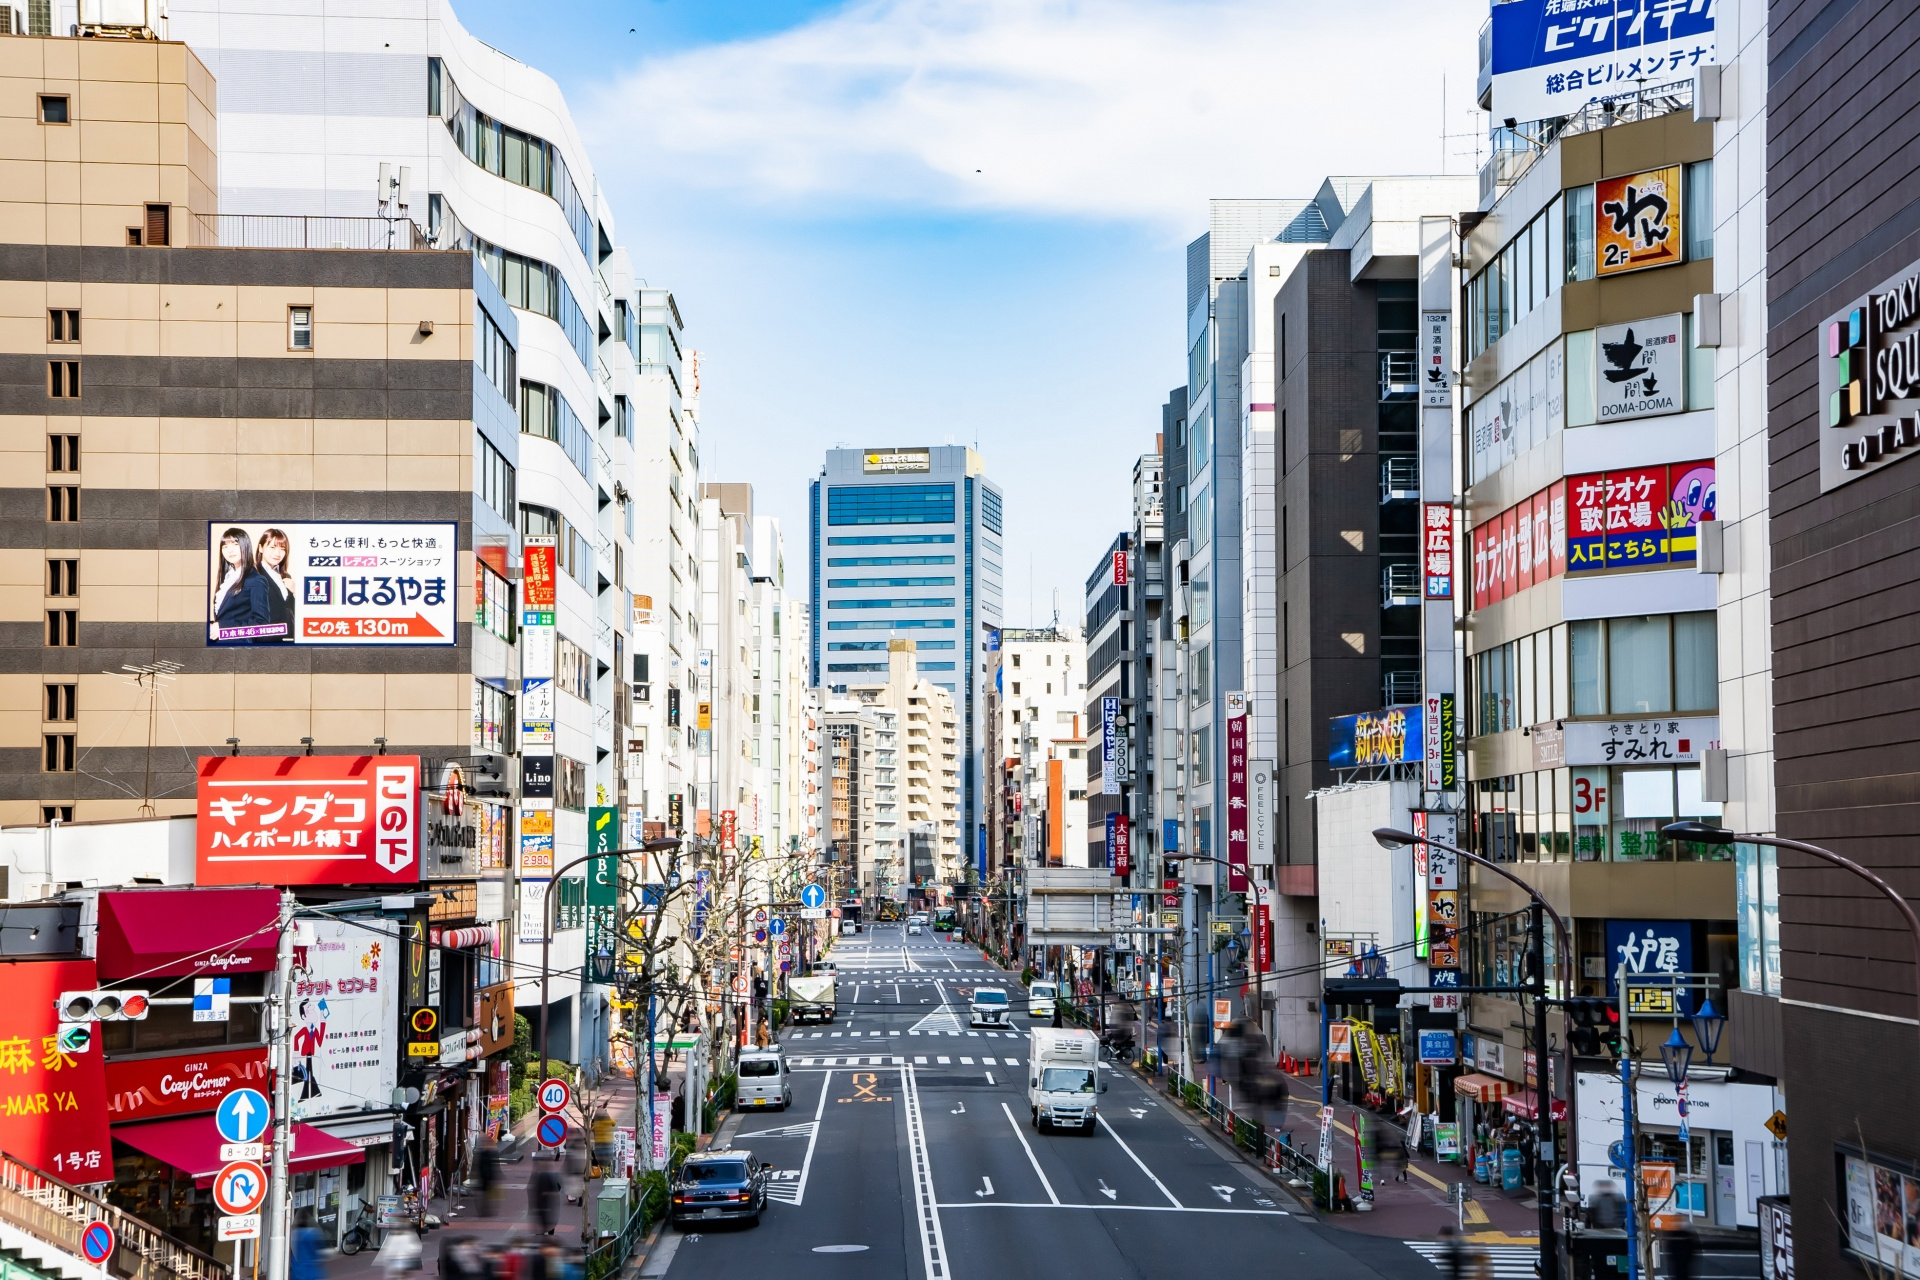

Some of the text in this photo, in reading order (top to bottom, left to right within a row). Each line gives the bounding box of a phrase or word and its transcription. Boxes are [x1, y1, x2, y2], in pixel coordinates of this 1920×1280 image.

[1602, 186, 1669, 248] わん
[1604, 244, 1629, 267] 2F
[1645, 335, 1669, 347] 居酒家
[1602, 397, 1673, 416] DOMA-DOMA
[1576, 475, 1656, 507] カラオケ
[1580, 501, 1652, 532] 歌広場
[309, 537, 443, 549] もっと便利、もっと快適。
[1427, 506, 1450, 575] 歌広場
[1475, 495, 1565, 594] カラオケ歌広場
[1570, 538, 1656, 563] 入口こちら
[312, 556, 442, 566] メンズ レディス スーツショップ
[341, 576, 446, 606] はるやま
[1429, 578, 1449, 594] 5F
[307, 620, 409, 635] この先 130m
[1105, 710, 1117, 761] はるやま
[1355, 710, 1407, 764] 新台入替
[1428, 715, 1440, 760] 当ビル 3F
[1608, 722, 1680, 736] やきとり家
[1231, 720, 1244, 784] 韓国料理
[1442, 699, 1454, 786] シティクリニック
[1601, 737, 1673, 761] すみれ
[1117, 738, 1126, 776] 2900
[525, 773, 551, 782] Lino
[1574, 777, 1606, 813] 3F
[209, 790, 366, 826] ギンダコ
[381, 775, 407, 865] この下
[1257, 787, 1265, 850] FEELCYCLE
[211, 828, 362, 849] ハイボール横丁
[1116, 823, 1128, 867] 大阪王将
[1447, 817, 1456, 866] やきと家
[595, 833, 608, 885] SMBC
[1430, 834, 1447, 875] すみれ
[1431, 898, 1456, 919] わん
[210, 953, 230, 970] Cozy
[229, 953, 252, 965] Corner
[1443, 954, 1457, 965] 2F
[296, 977, 377, 996] チケット セブン-2
[1432, 994, 1458, 1009] 歯科
[195, 1010, 227, 1021] 時差式
[412, 1045, 435, 1054] 春日亭
[1425, 1040, 1451, 1049] 英会話
[184, 1062, 209, 1073] GINZA
[160, 1072, 231, 1100] Cozy Corner
[545, 1088, 563, 1104] 40
[53, 1151, 102, 1172] 1号店
